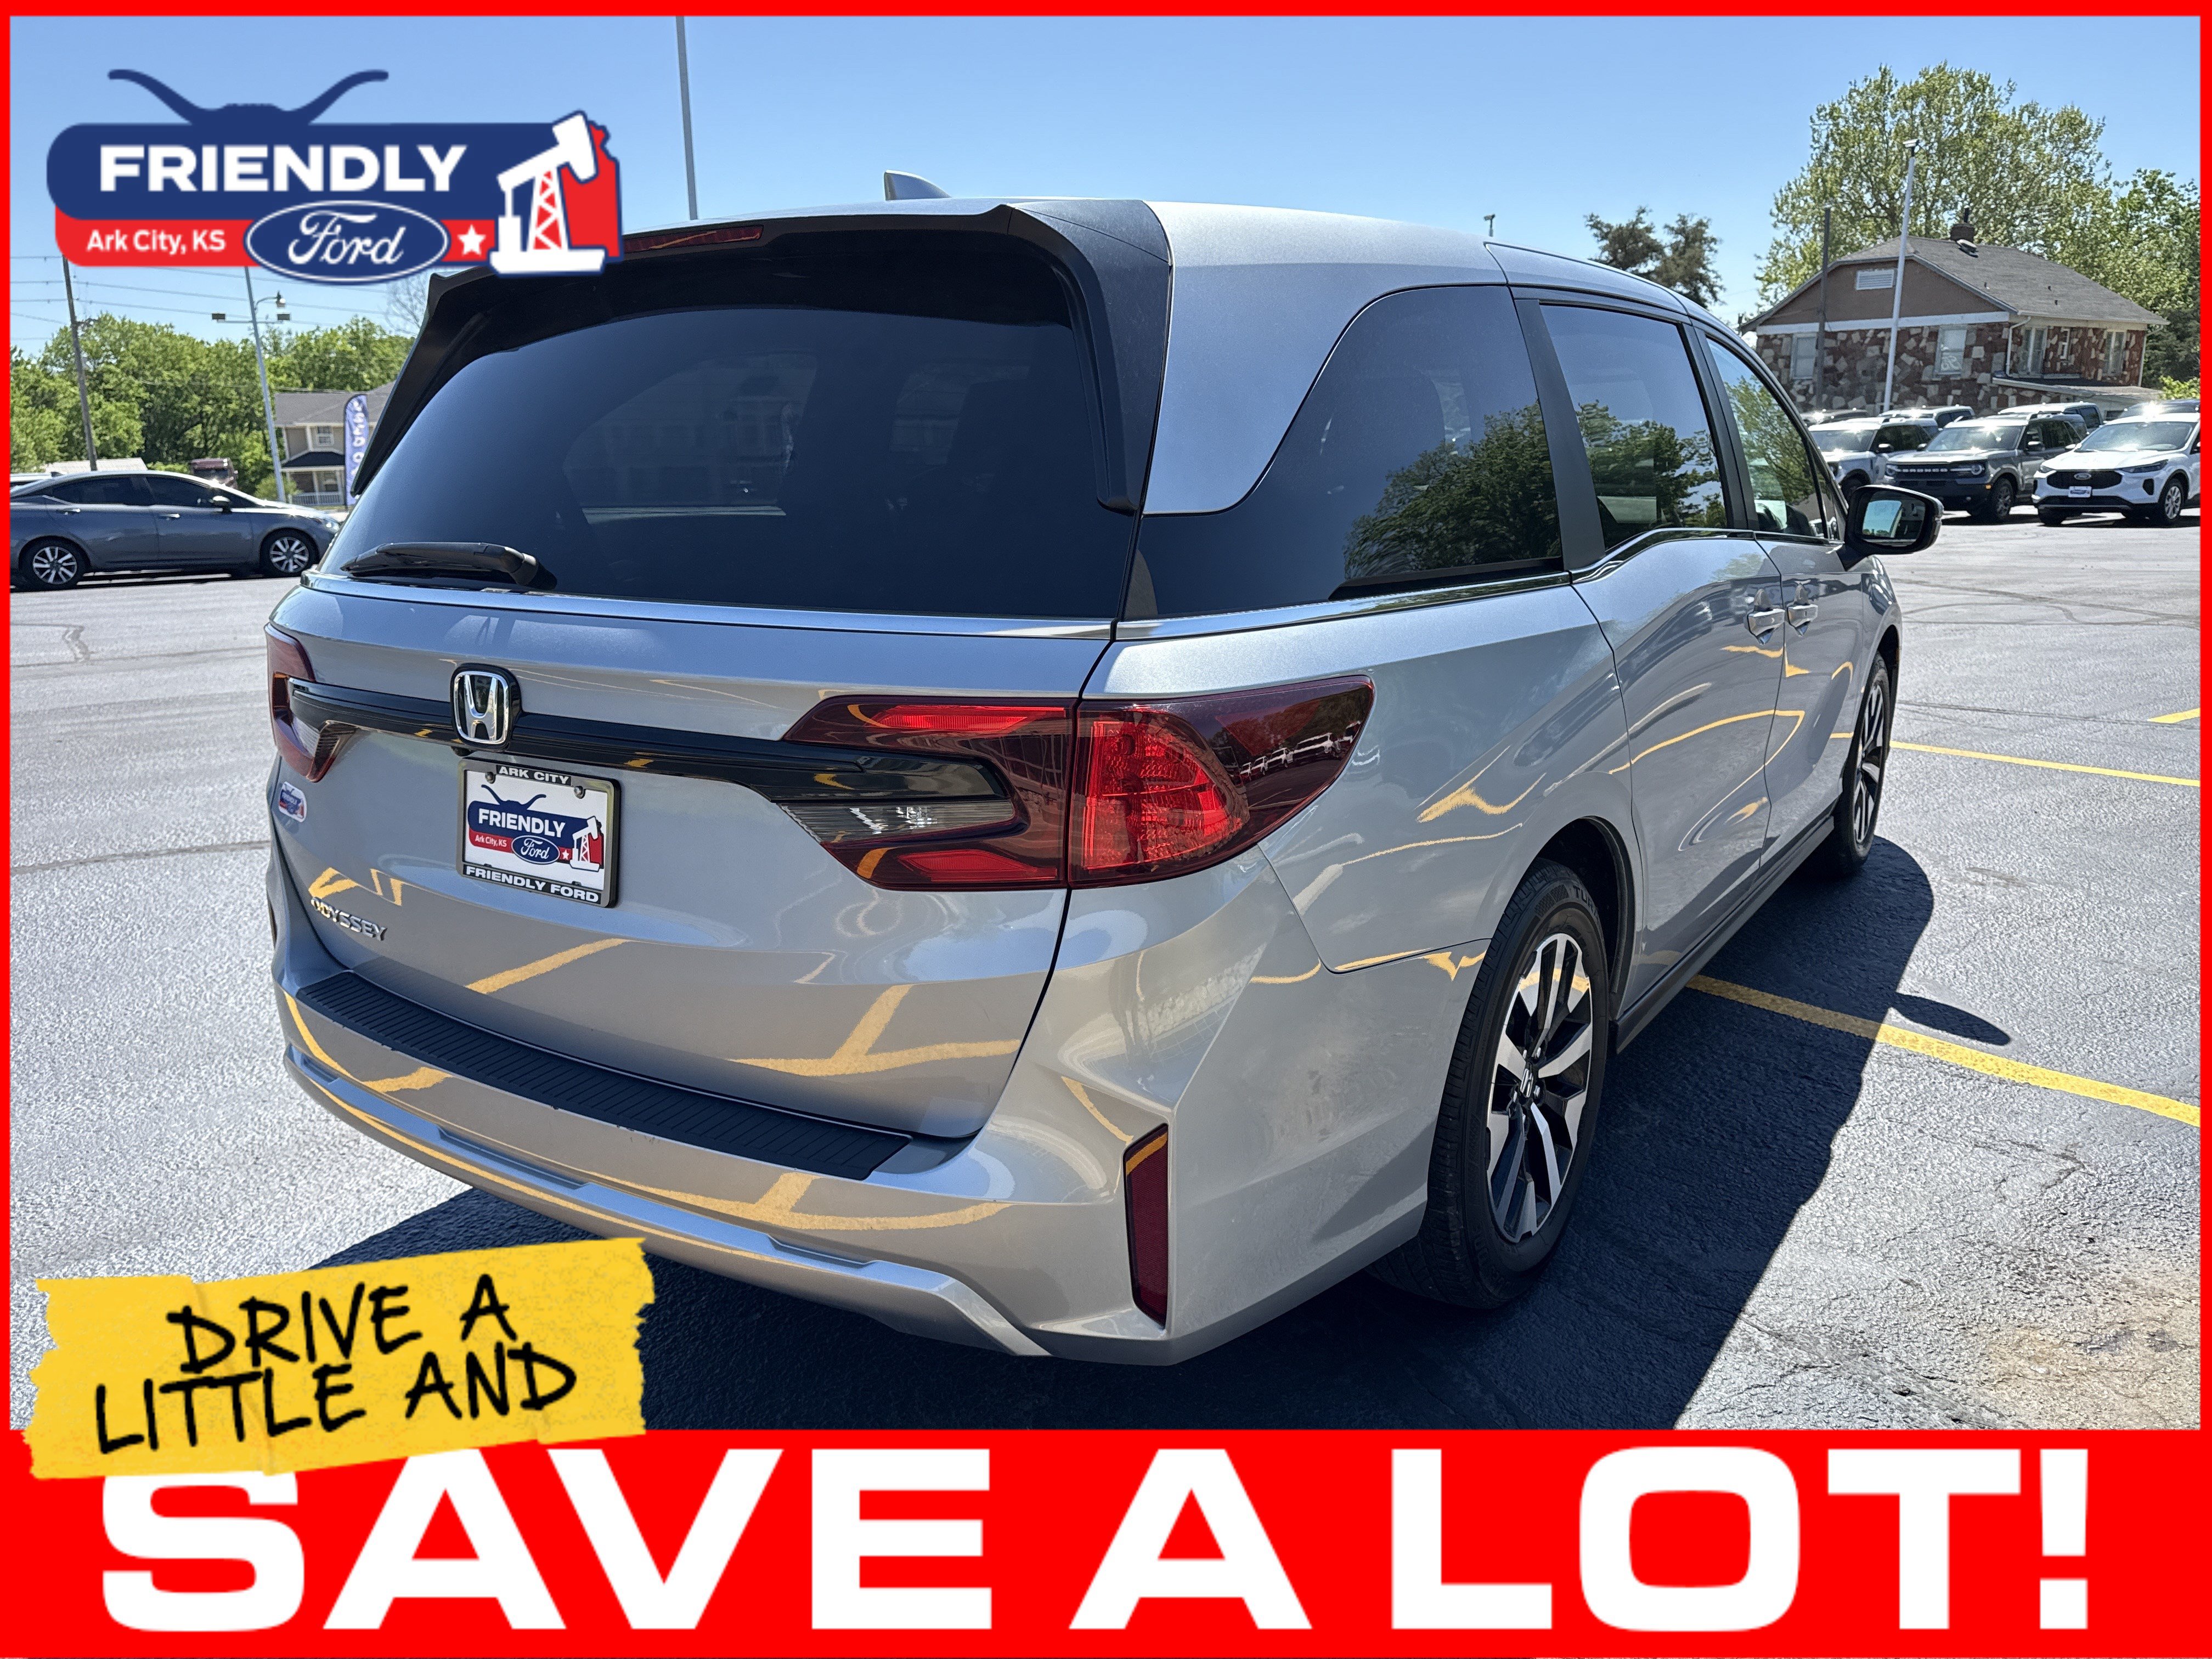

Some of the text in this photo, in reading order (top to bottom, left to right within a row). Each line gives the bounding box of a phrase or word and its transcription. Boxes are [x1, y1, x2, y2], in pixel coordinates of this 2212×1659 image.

[499, 766, 569, 785] ARK CITY
[478, 808, 566, 838] FRIENDLY
[475, 834, 507, 848] Ark City, KS
[521, 837, 550, 860] Ford
[466, 866, 600, 902] FRIENDLY FORD
[311, 898, 387, 941] ODYSSEY
